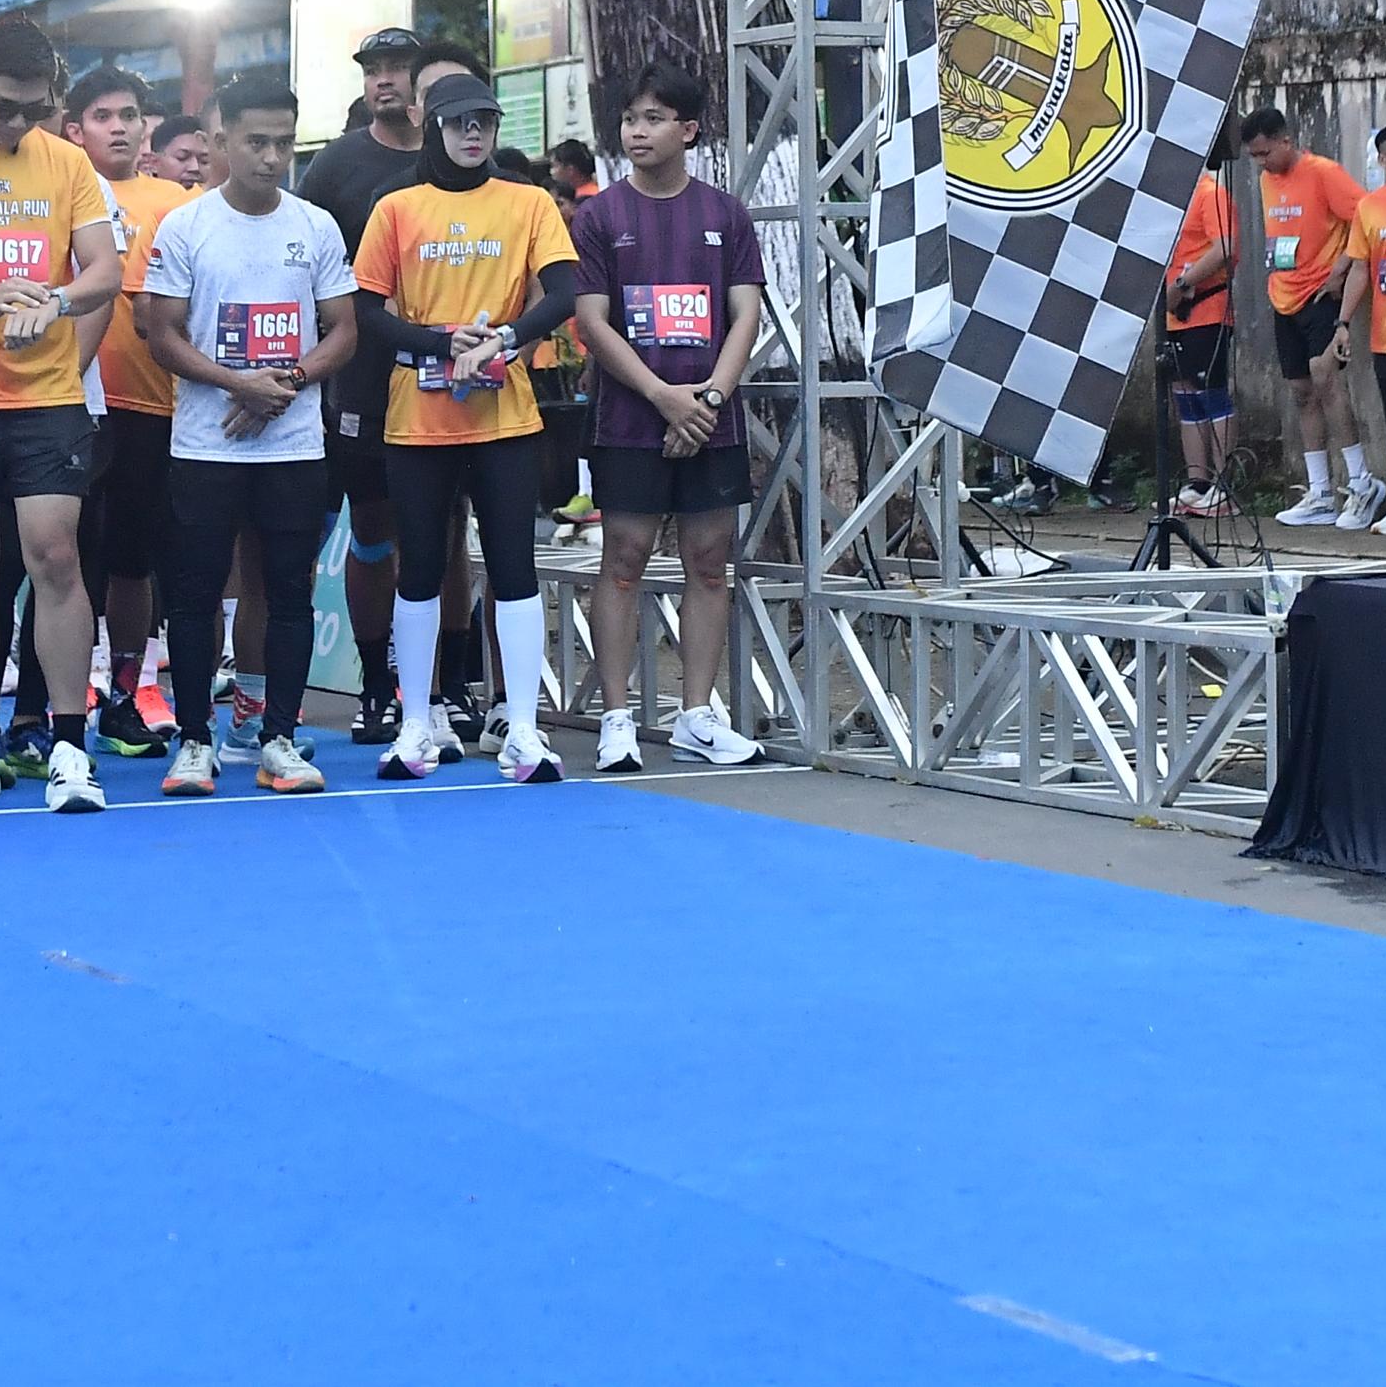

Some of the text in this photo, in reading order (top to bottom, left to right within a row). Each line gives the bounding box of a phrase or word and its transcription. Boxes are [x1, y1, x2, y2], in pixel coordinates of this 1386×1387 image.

[22, 200, 50, 218] RUN
[419, 240, 502, 262] MENYALA RUN
[7, 267, 29, 277] OPEN
[657, 293, 708, 318] 1620
[252, 312, 299, 338] 1664
